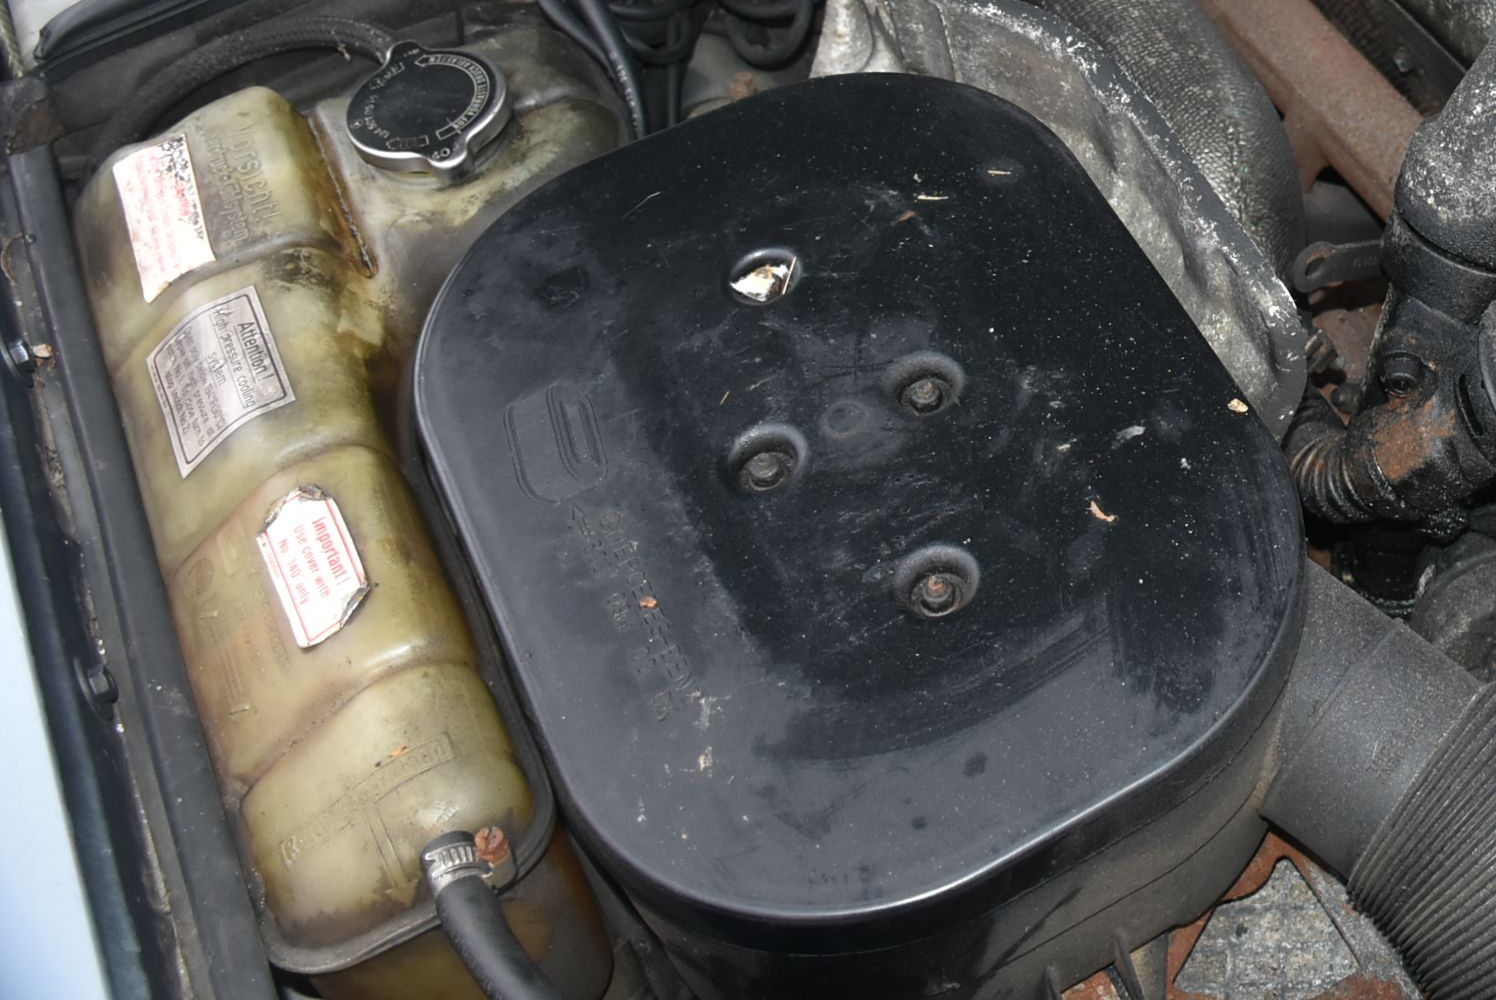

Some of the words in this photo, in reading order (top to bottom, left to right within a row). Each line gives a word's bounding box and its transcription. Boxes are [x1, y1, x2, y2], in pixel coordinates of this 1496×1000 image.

[217, 331, 245, 375] pressure
[232, 373, 259, 409] cooling
[292, 524, 308, 546] Use
[300, 545, 319, 574] cover
[313, 574, 329, 599] with
